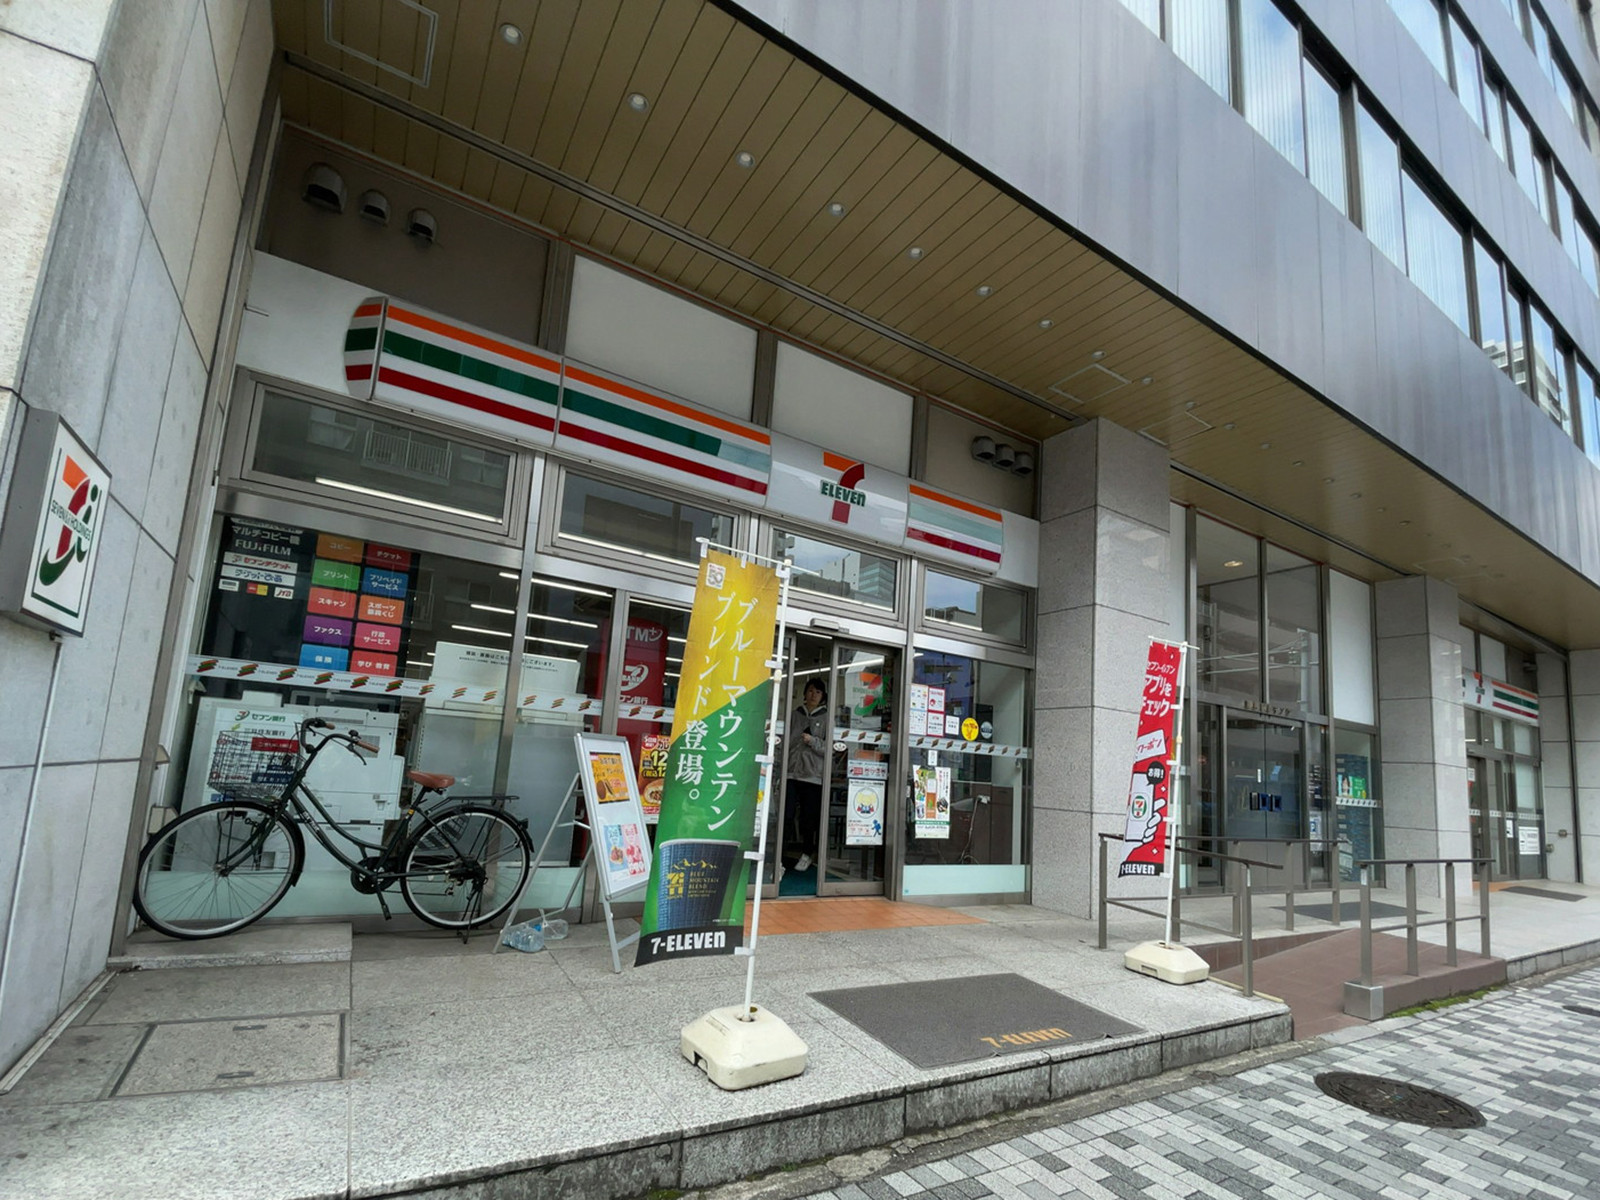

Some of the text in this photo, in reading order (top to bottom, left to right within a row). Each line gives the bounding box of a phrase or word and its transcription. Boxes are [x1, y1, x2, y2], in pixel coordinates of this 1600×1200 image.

[376, 550, 402, 560] チケット
[323, 569, 350, 579] プリント
[371, 581, 399, 591] サービス
[318, 597, 347, 607] スキャン
[367, 602, 396, 611] スポーツ
[313, 625, 342, 635] ファクス
[363, 636, 392, 646] サービス
[675, 591, 737, 802] ブレンド登場。
[252, 713, 286, 723] セブン銀行
[707, 597, 760, 832] ブルーマウンテン
